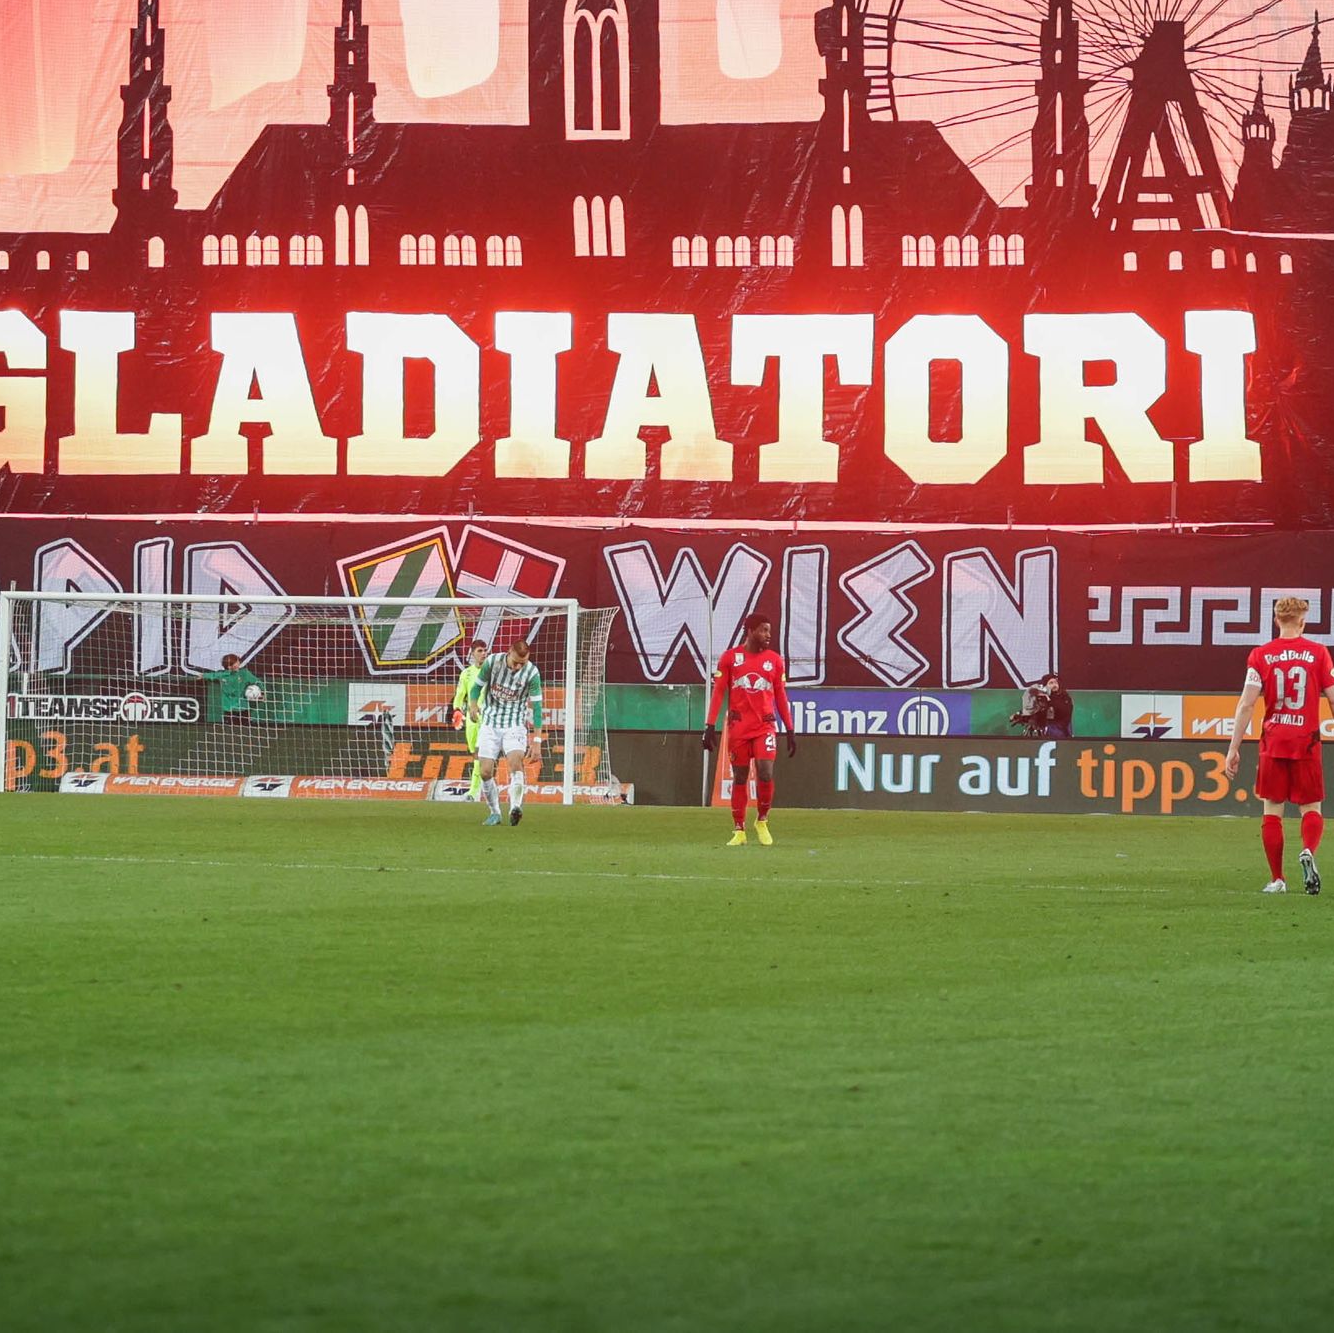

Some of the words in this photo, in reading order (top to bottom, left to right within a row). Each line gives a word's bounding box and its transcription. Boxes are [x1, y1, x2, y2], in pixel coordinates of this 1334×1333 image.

[602, 539, 1058, 691] WIEN
[1273, 666, 1307, 710] 13
[112, 776, 160, 786] WIEN
[161, 777, 239, 788] ENERGIE
[297, 778, 345, 789] WIEN
[346, 779, 427, 792] ENERGIE
[836, 743, 941, 794] Nur
[958, 740, 1058, 797] auf
